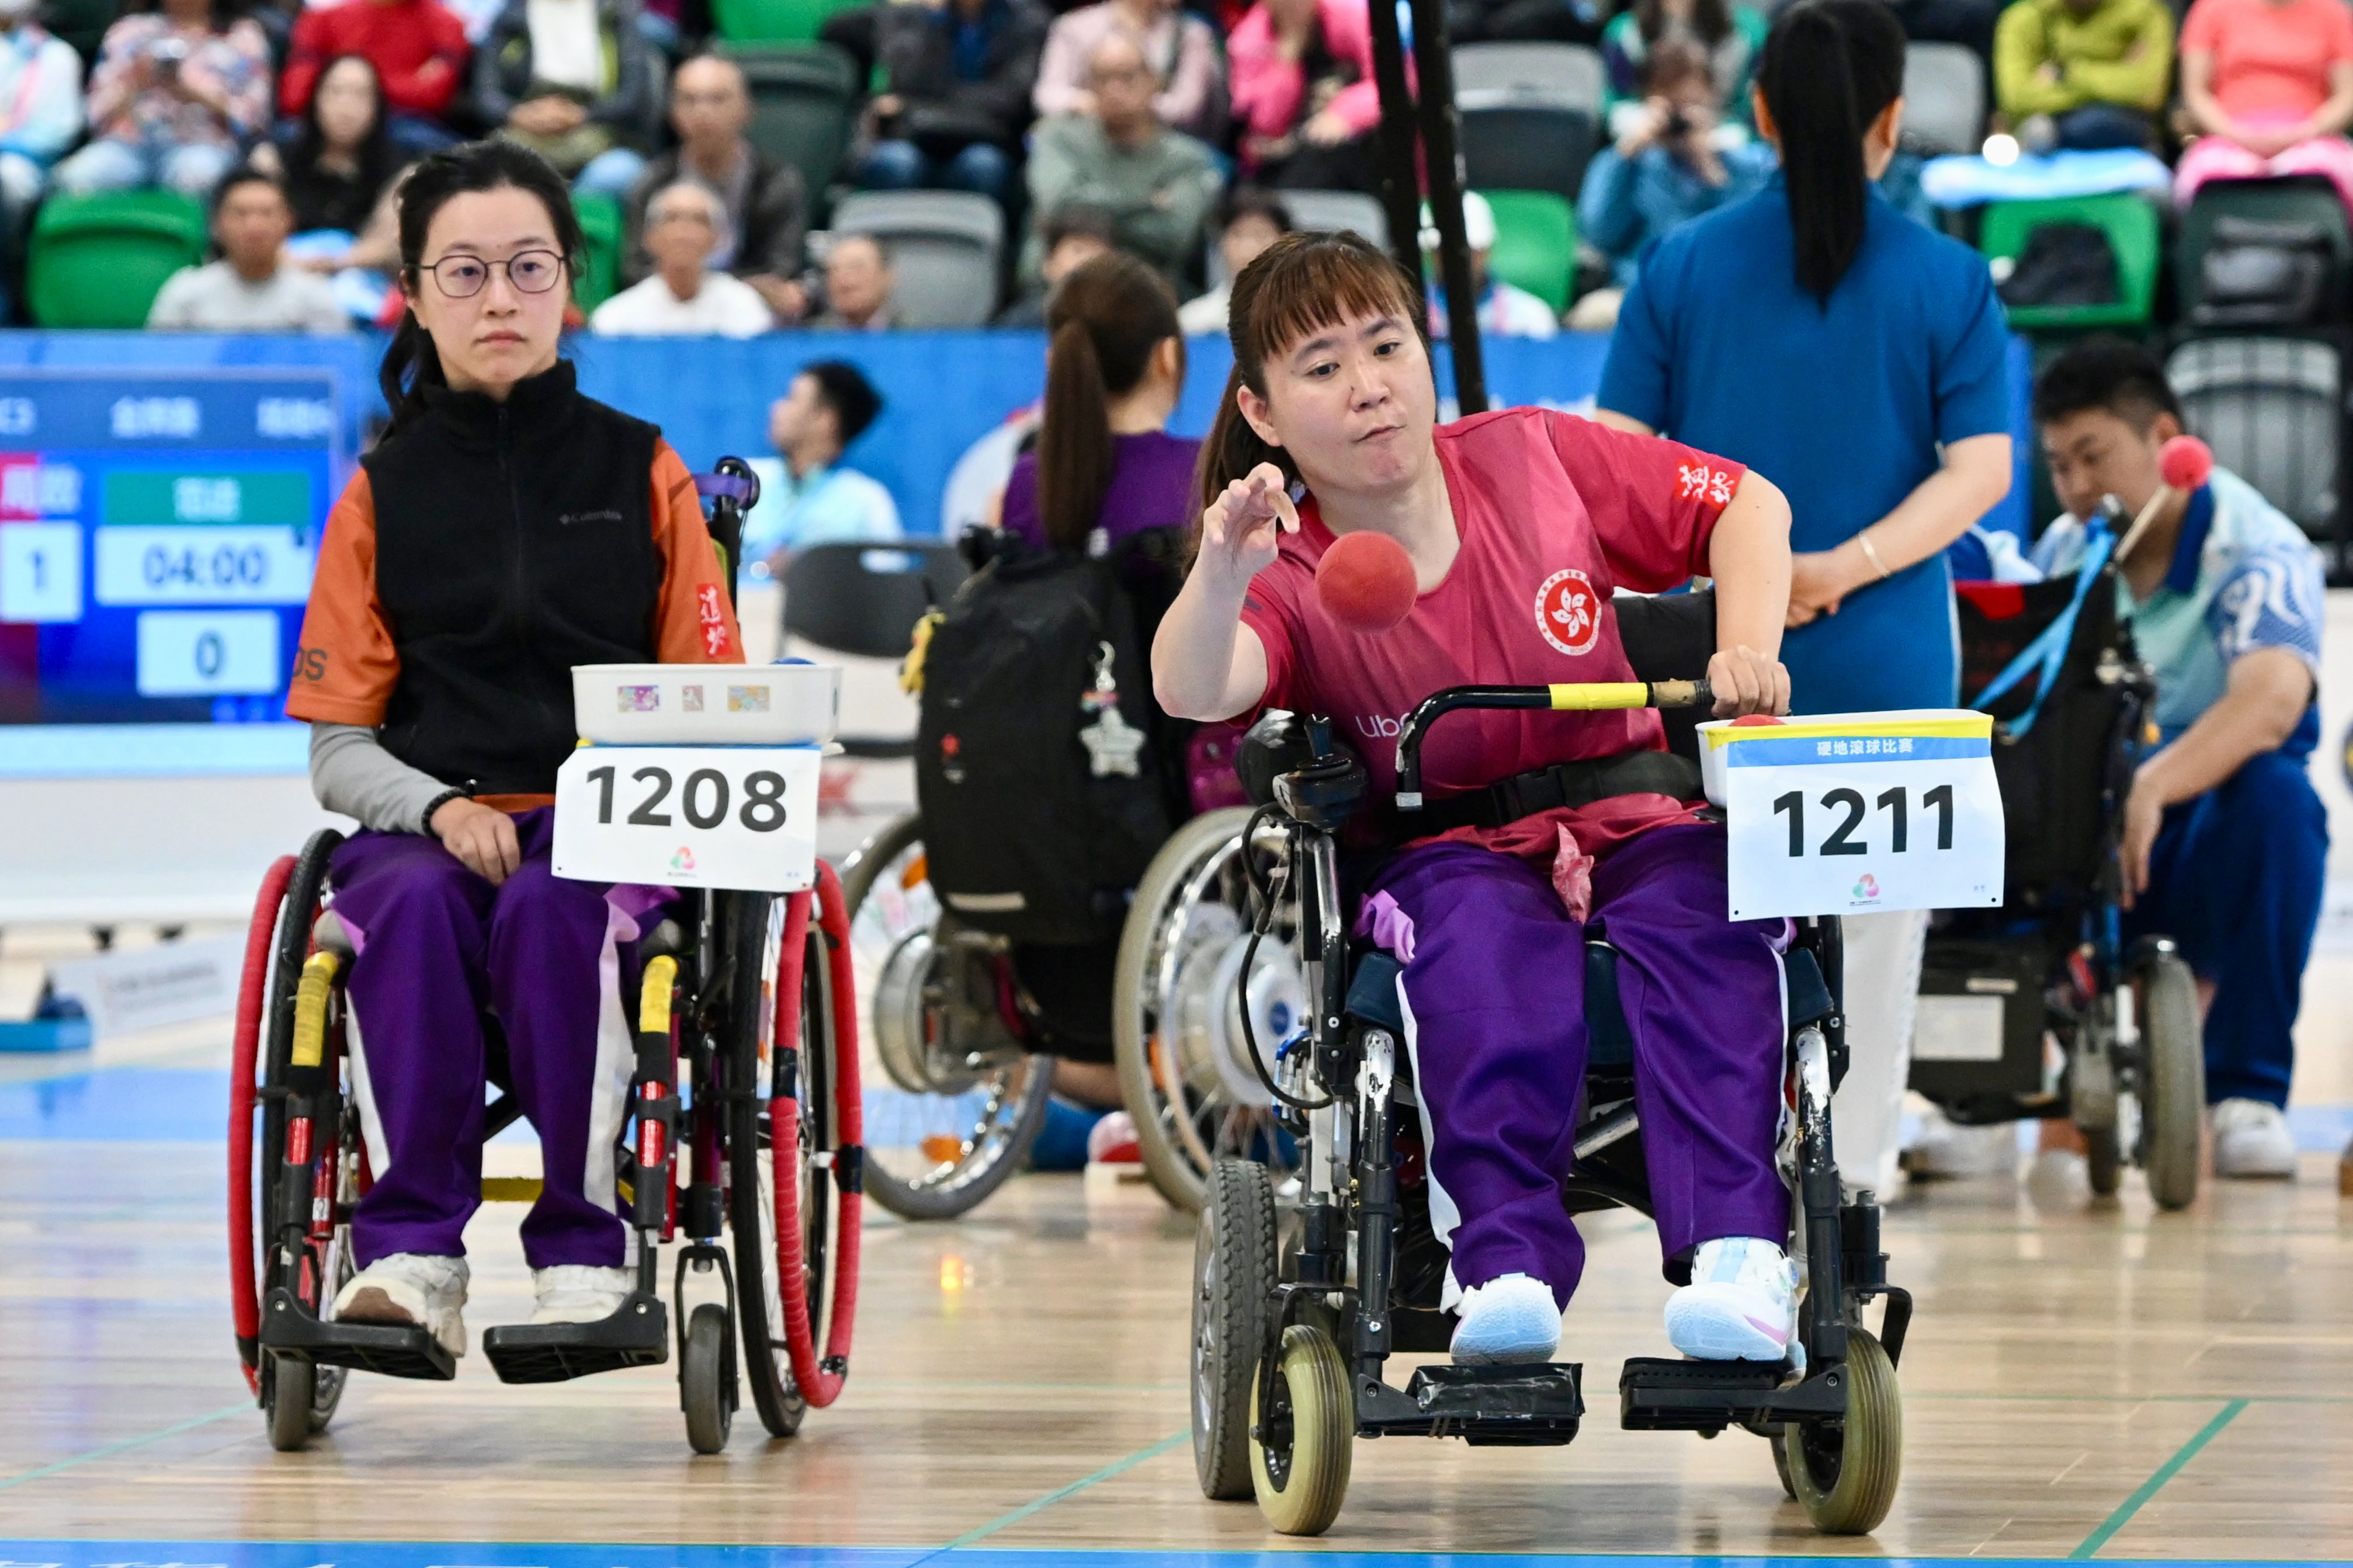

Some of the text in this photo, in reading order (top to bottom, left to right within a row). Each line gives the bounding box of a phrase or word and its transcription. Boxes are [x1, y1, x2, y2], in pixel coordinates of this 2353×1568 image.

[30, 551, 48, 589] 1
[143, 545, 268, 586] 04:00
[196, 632, 224, 677] 0
[1817, 738, 1913, 756] 硬地滚球比赛
[586, 765, 786, 832] 1208
[1773, 784, 1953, 857] 1211
